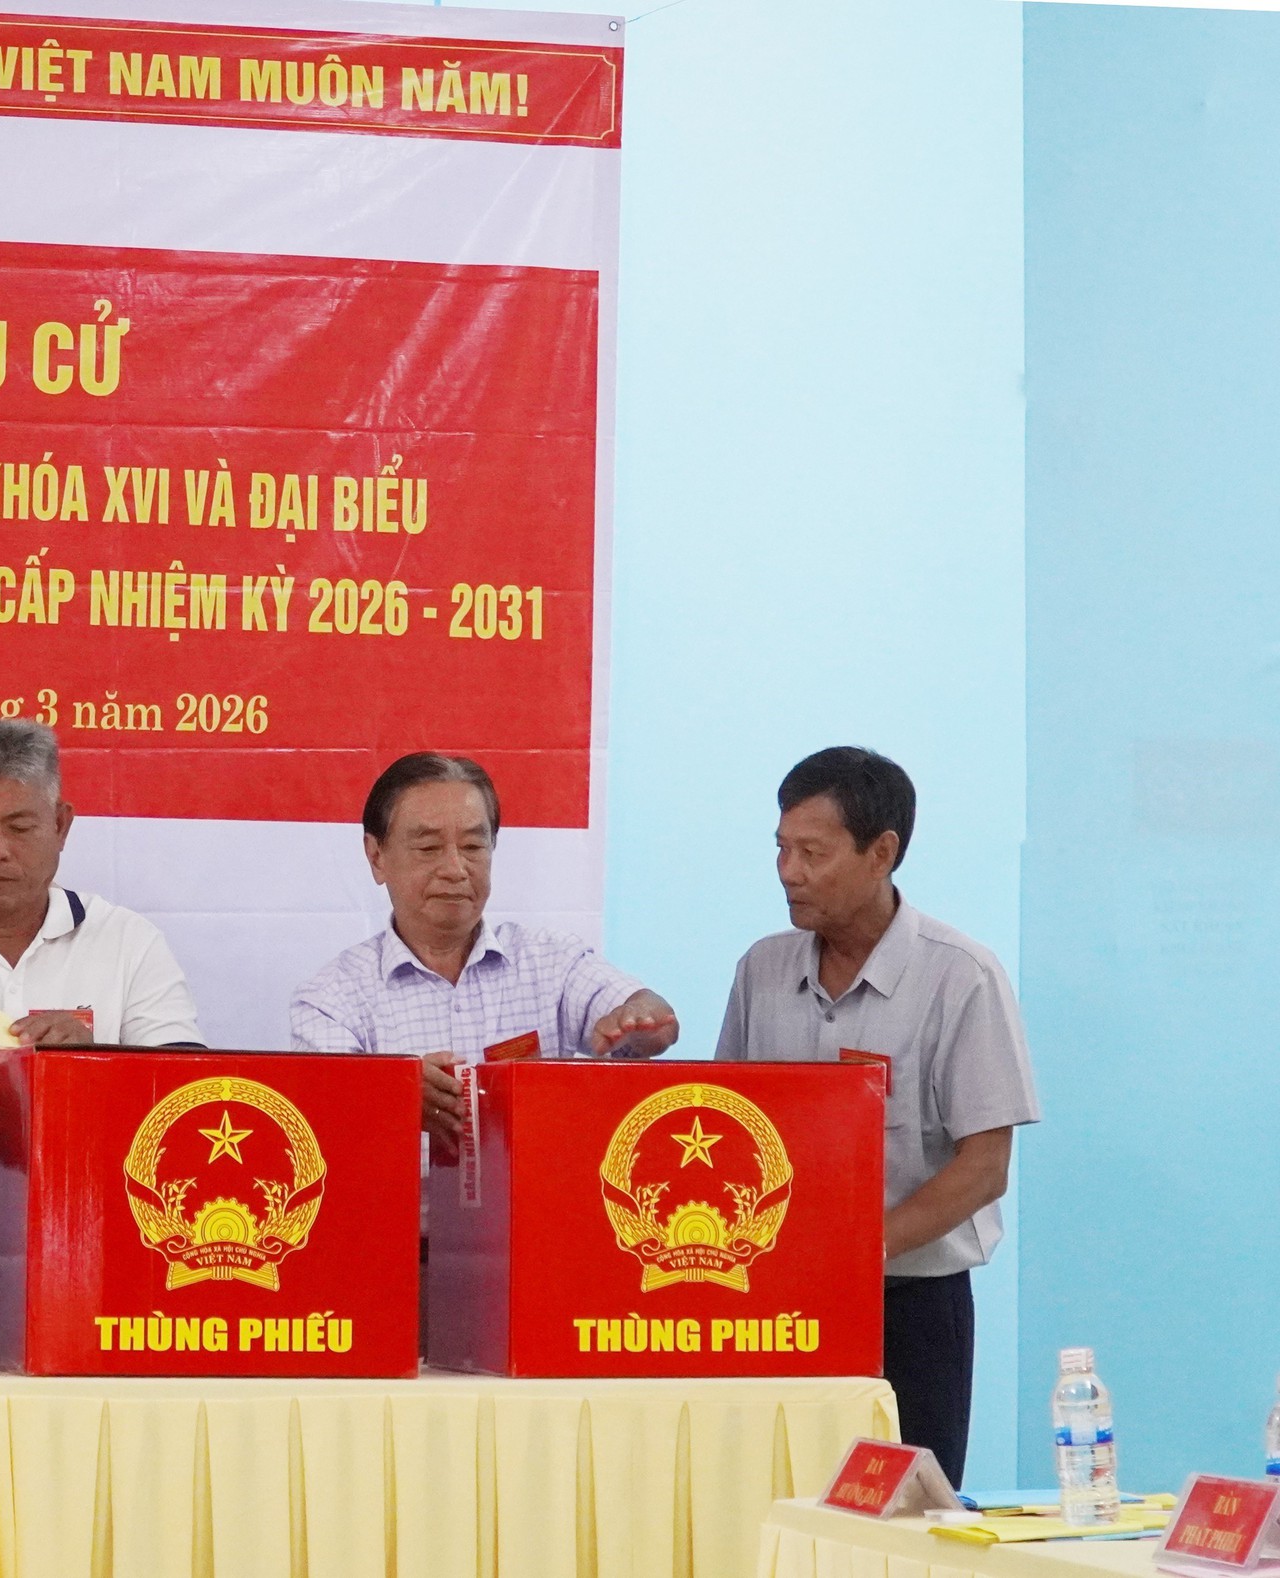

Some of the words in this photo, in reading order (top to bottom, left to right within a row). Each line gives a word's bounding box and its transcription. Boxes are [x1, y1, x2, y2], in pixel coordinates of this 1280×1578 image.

[110, 52, 221, 99] NAM
[240, 54, 384, 107] MUÔN
[402, 60, 528, 116] NĂM!
[33, 301, 129, 396] CỬ
[103, 467, 169, 524] XVI
[184, 459, 236, 527] VÀ
[249, 473, 318, 542] ĐẠI
[333, 455, 427, 534] BIỂU
[90, 560, 227, 641] NHIỆM
[242, 564, 295, 632] KỲ
[308, 578, 408, 636] 2026
[423, 607, 437, 618] -
[449, 583, 542, 640] 2031
[36, 689, 57, 726] 3
[73, 692, 162, 730] năm
[176, 693, 268, 733] 2026
[196, 1252, 224, 1266] VIỆT
[227, 1254, 252, 1266] NAM
[670, 1256, 695, 1268] VIỆT
[700, 1257, 723, 1268] NAM
[95, 1311, 227, 1351] THÙNG
[239, 1311, 352, 1352] PHIẾU
[573, 1313, 700, 1352] THÙNG
[711, 1312, 819, 1352] PHIẾU
